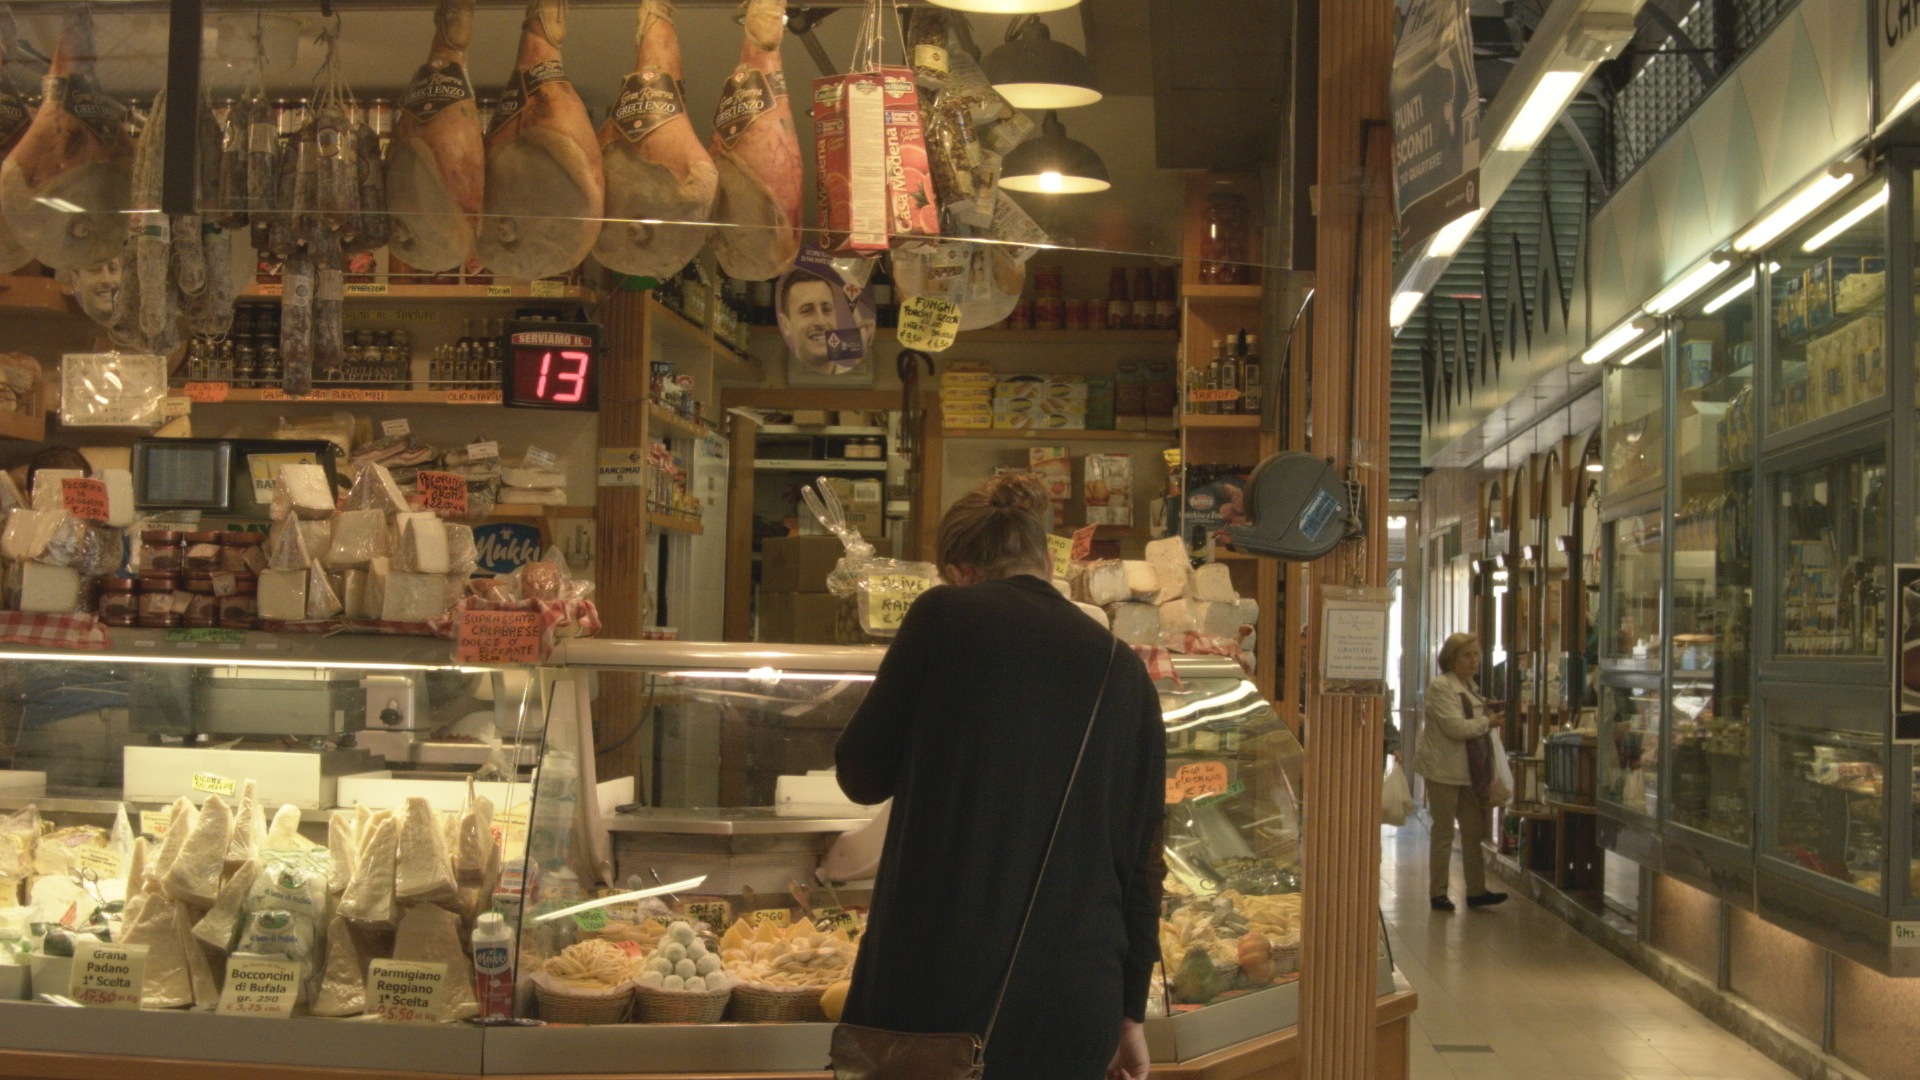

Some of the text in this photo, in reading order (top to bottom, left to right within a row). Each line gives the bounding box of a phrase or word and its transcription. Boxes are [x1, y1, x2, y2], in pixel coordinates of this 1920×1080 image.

[434, 86, 465, 97] ENZO
[616, 100, 676, 117] GRECI ENZO
[715, 99, 764, 125] GRECI ENZO
[886, 127, 908, 192] Modena
[817, 139, 829, 207] Modena
[896, 193, 912, 233] Casa
[915, 296, 956, 314] FUNGHI
[518, 333, 584, 346] SERVIAMO IL
[535, 350, 590, 403] 13
[599, 466, 640, 474] BANCOMAT
[475, 533, 541, 568] Mukki
[471, 625, 538, 637] CALABRESE
[462, 638, 500, 647] DOLCE
[93, 950, 127, 961] Grana
[87, 962, 130, 975] Padano
[231, 968, 294, 981] Bocconcini
[373, 967, 441, 982] Parmigiano
[96, 977, 131, 988] Scelta
[235, 982, 286, 994] di Bufala
[377, 980, 433, 995] Reggiano
[257, 995, 279, 1003] 250
[392, 995, 429, 1008] Scelta
